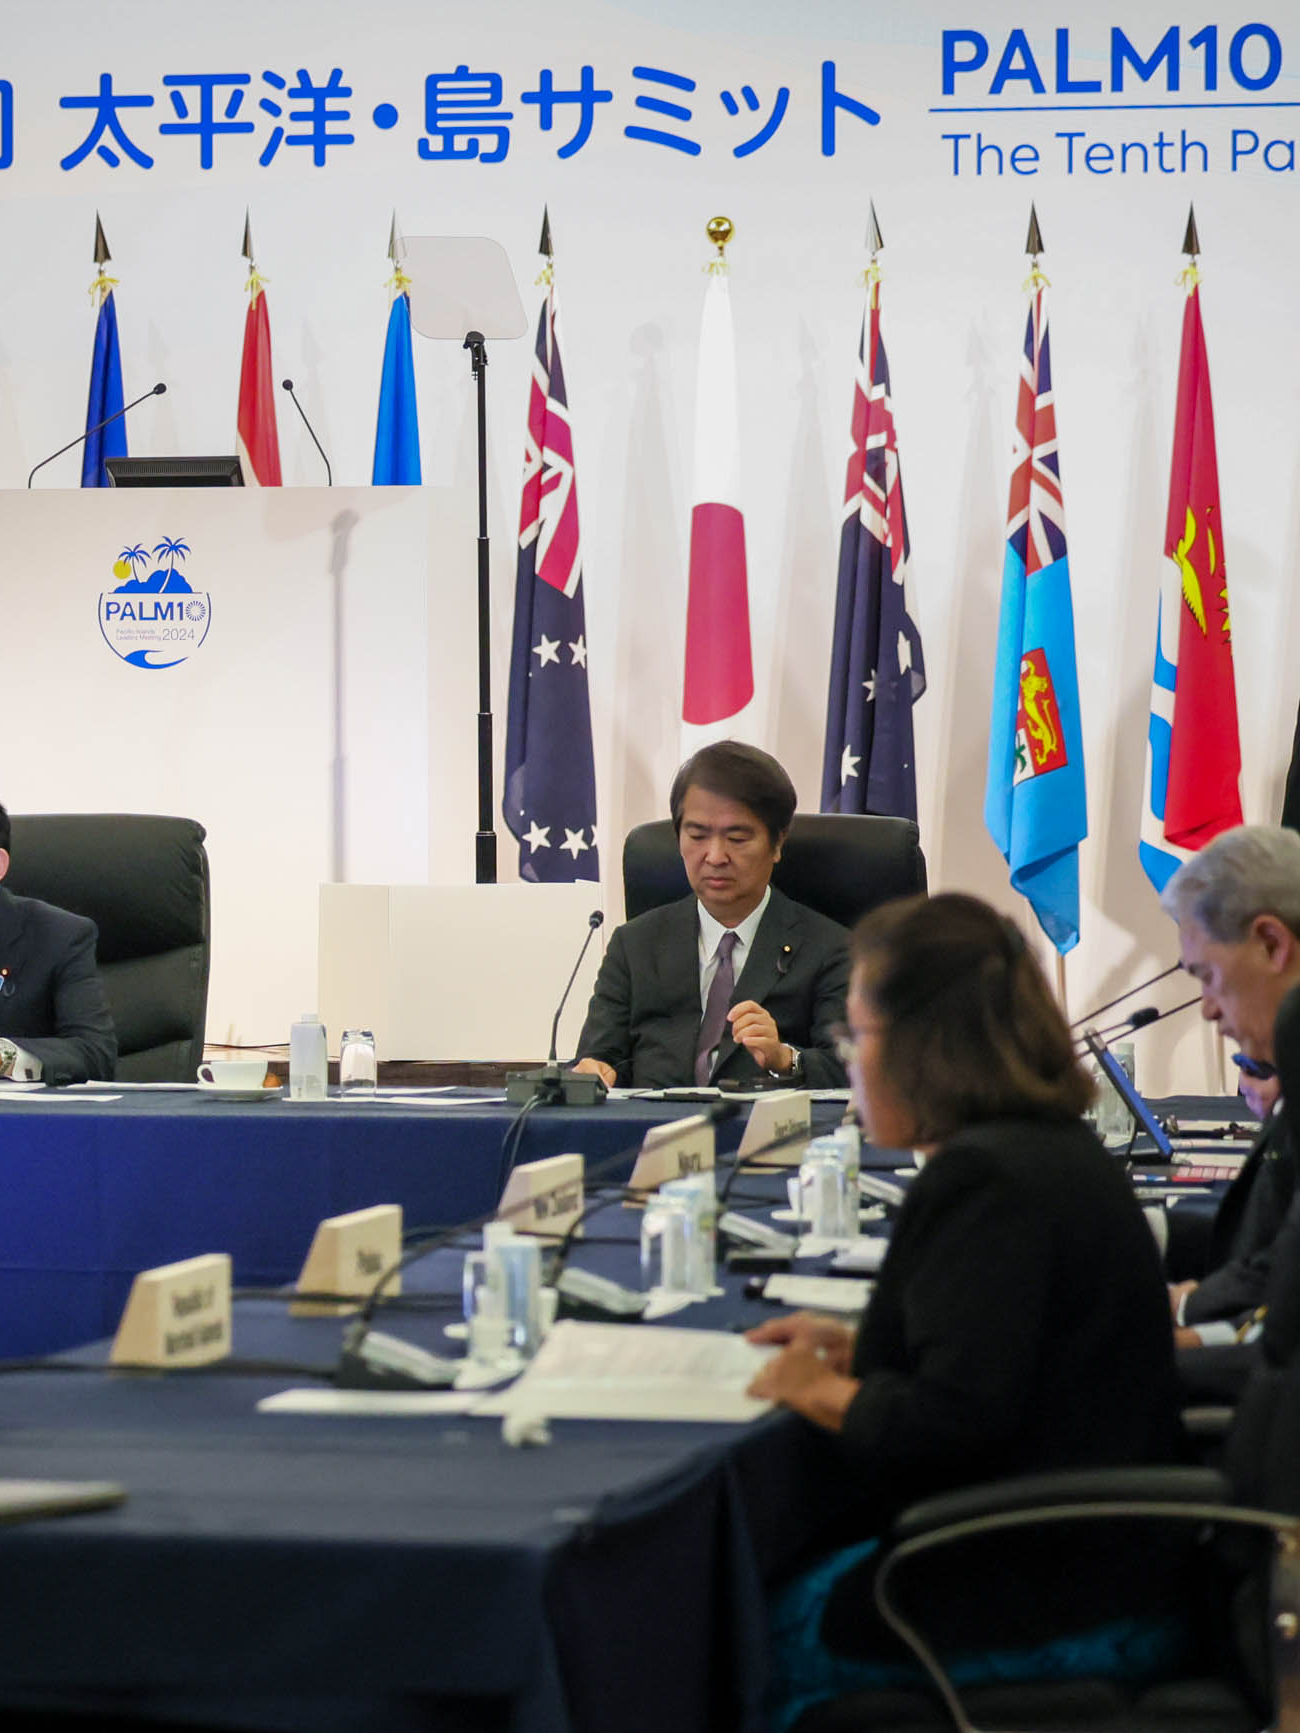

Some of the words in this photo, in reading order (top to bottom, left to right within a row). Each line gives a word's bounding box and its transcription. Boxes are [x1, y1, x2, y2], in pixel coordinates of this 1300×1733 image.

[941, 22, 1283, 97] PALM10
[59, 60, 882, 172] 太平洋・島サミット
[941, 131, 1041, 177] The
[1054, 128, 1209, 175] Tenth
[105, 600, 207, 622] PALM10
[162, 628, 196, 641] 2024
